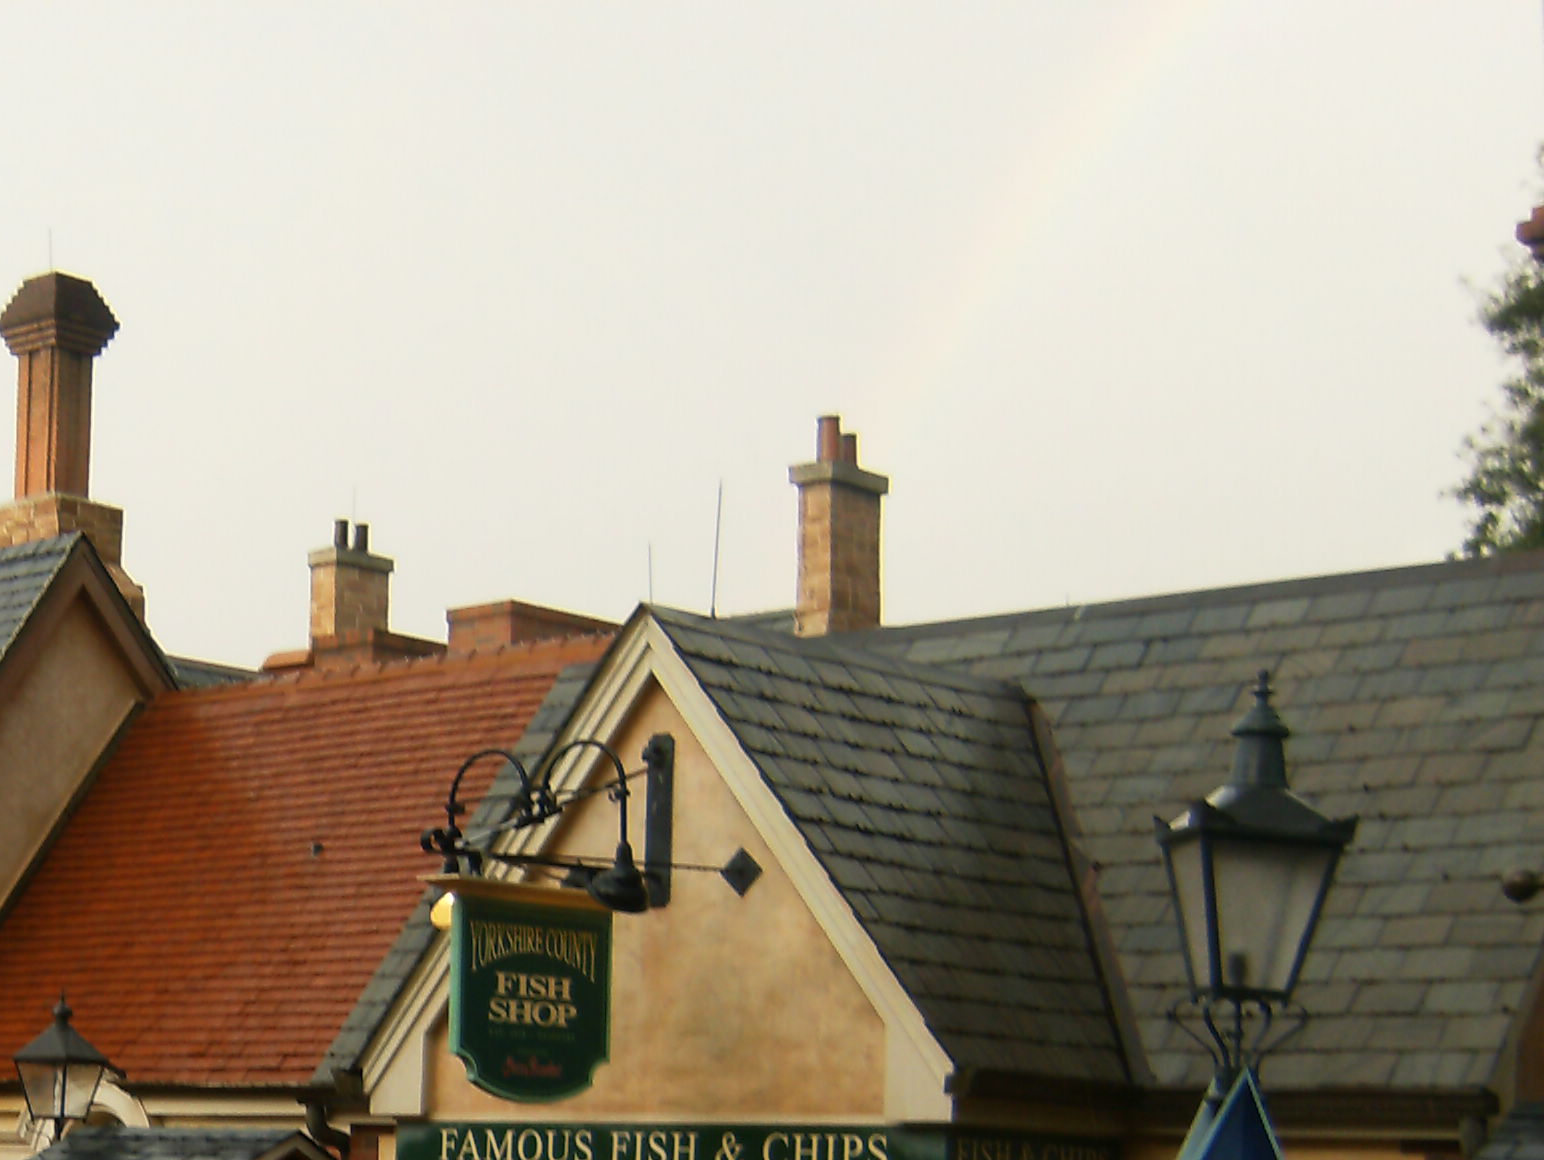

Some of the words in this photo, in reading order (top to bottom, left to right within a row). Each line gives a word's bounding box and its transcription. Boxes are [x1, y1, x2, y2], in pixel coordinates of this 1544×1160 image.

[470, 920, 542, 971] YORKSHIRE
[545, 928, 597, 984] COUNTY
[495, 970, 572, 1001] FISH
[488, 997, 578, 1028] SHOP
